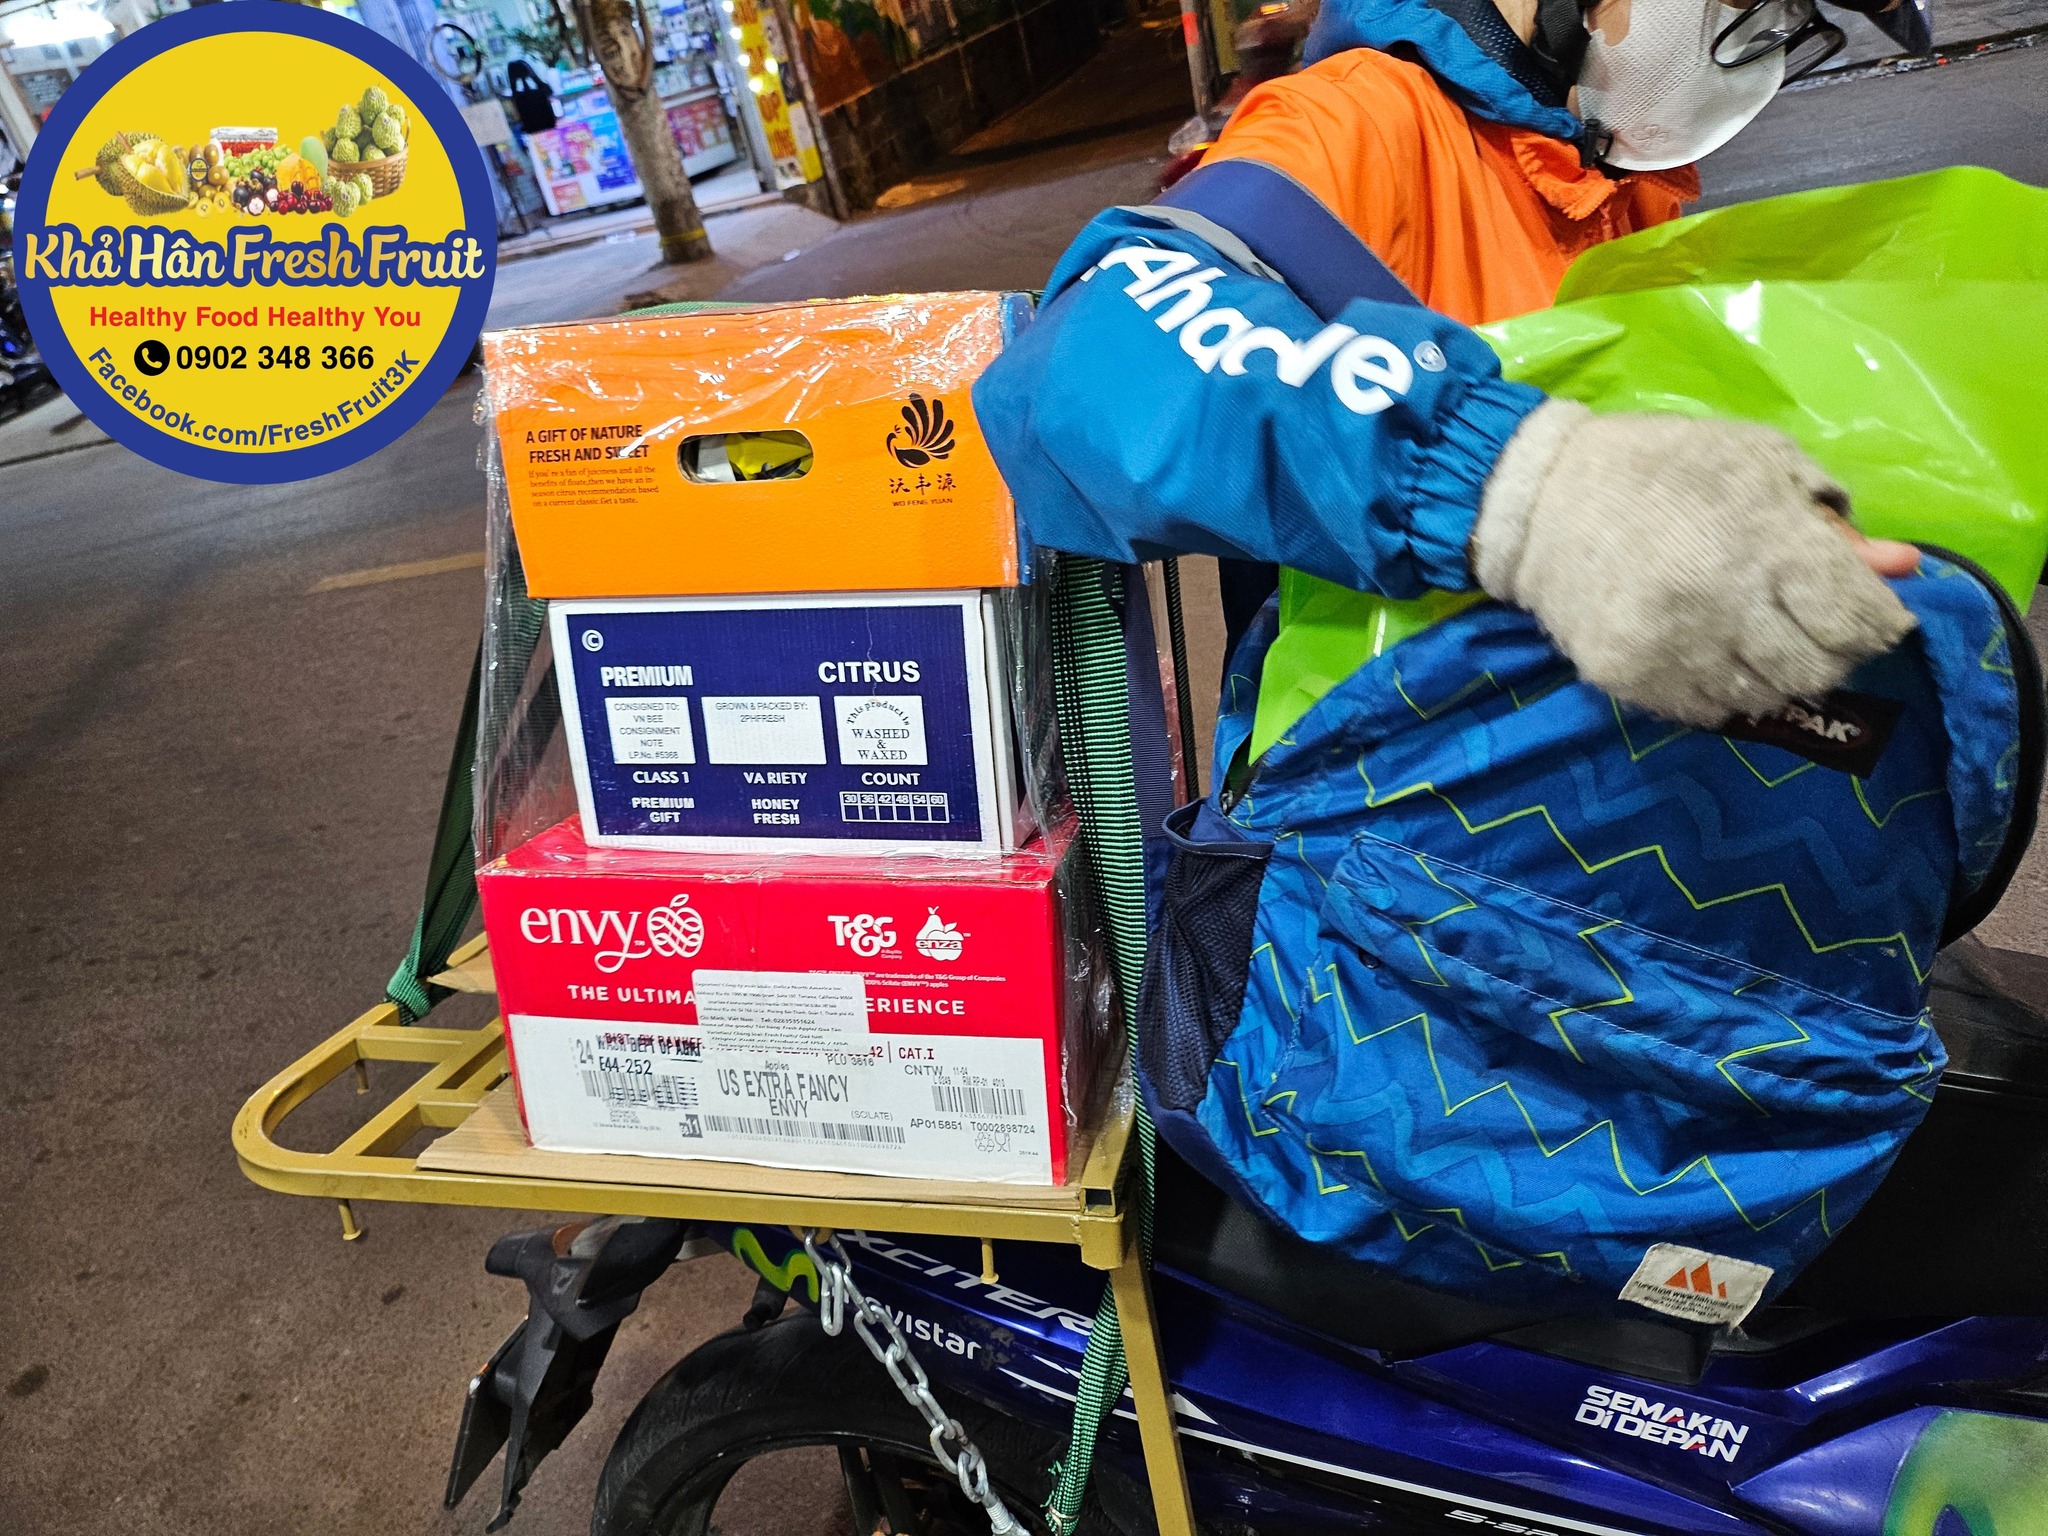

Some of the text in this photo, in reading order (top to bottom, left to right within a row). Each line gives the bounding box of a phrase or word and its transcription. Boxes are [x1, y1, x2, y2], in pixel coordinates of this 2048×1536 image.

[526, 425, 642, 443] A GIFT OF NATURE
[529, 445, 649, 463] FRESH AND SWET
[578, 468, 586, 476] of
[530, 479, 557, 487] benefits
[556, 489, 576, 497] citrus
[578, 487, 637, 496] recommendation
[638, 486, 659, 494] based
[548, 499, 575, 507] current
[600, 661, 920, 687] PREMIUM CITRUS
[614, 702, 664, 711] CONSIGNED
[715, 702, 749, 710] GROWN
[751, 702, 756, 710] &
[758, 702, 792, 710] PACKED
[846, 706, 864, 724] This
[864, 700, 904, 717] product
[633, 715, 664, 723] VN BEE
[620, 727, 681, 735] CONSIGNMENT
[851, 728, 910, 739] WASHED
[640, 739, 664, 747] NOTE
[877, 739, 887, 749] &
[857, 749, 908, 760] WAXED
[633, 771, 690, 784] CLASS 1
[861, 772, 920, 785] COUNT
[631, 797, 695, 809] PREMIUM
[751, 798, 800, 810] HONEY
[878, 794, 891, 804] 42
[896, 795, 909, 804] 48
[913, 795, 926, 804] 54
[650, 812, 680, 823] GIFT
[753, 813, 800, 825] FRESH
[520, 907, 652, 974] envy
[916, 940, 962, 949] enza
[949, 974, 966, 982] Group
[567, 985, 609, 1001] THE
[599, 1056, 653, 1075] E44-252
[765, 1060, 790, 1071] Apples
[827, 1055, 847, 1066] PLU
[904, 1064, 943, 1076] CNTW
[717, 1068, 849, 1102] US EXTRA FANCY
[769, 1099, 808, 1118] ENVY
[851, 1110, 894, 1122] (SCILATE)
[910, 1118, 962, 1131] AP015851
[1614, 1413, 1741, 1463] DEPAN
